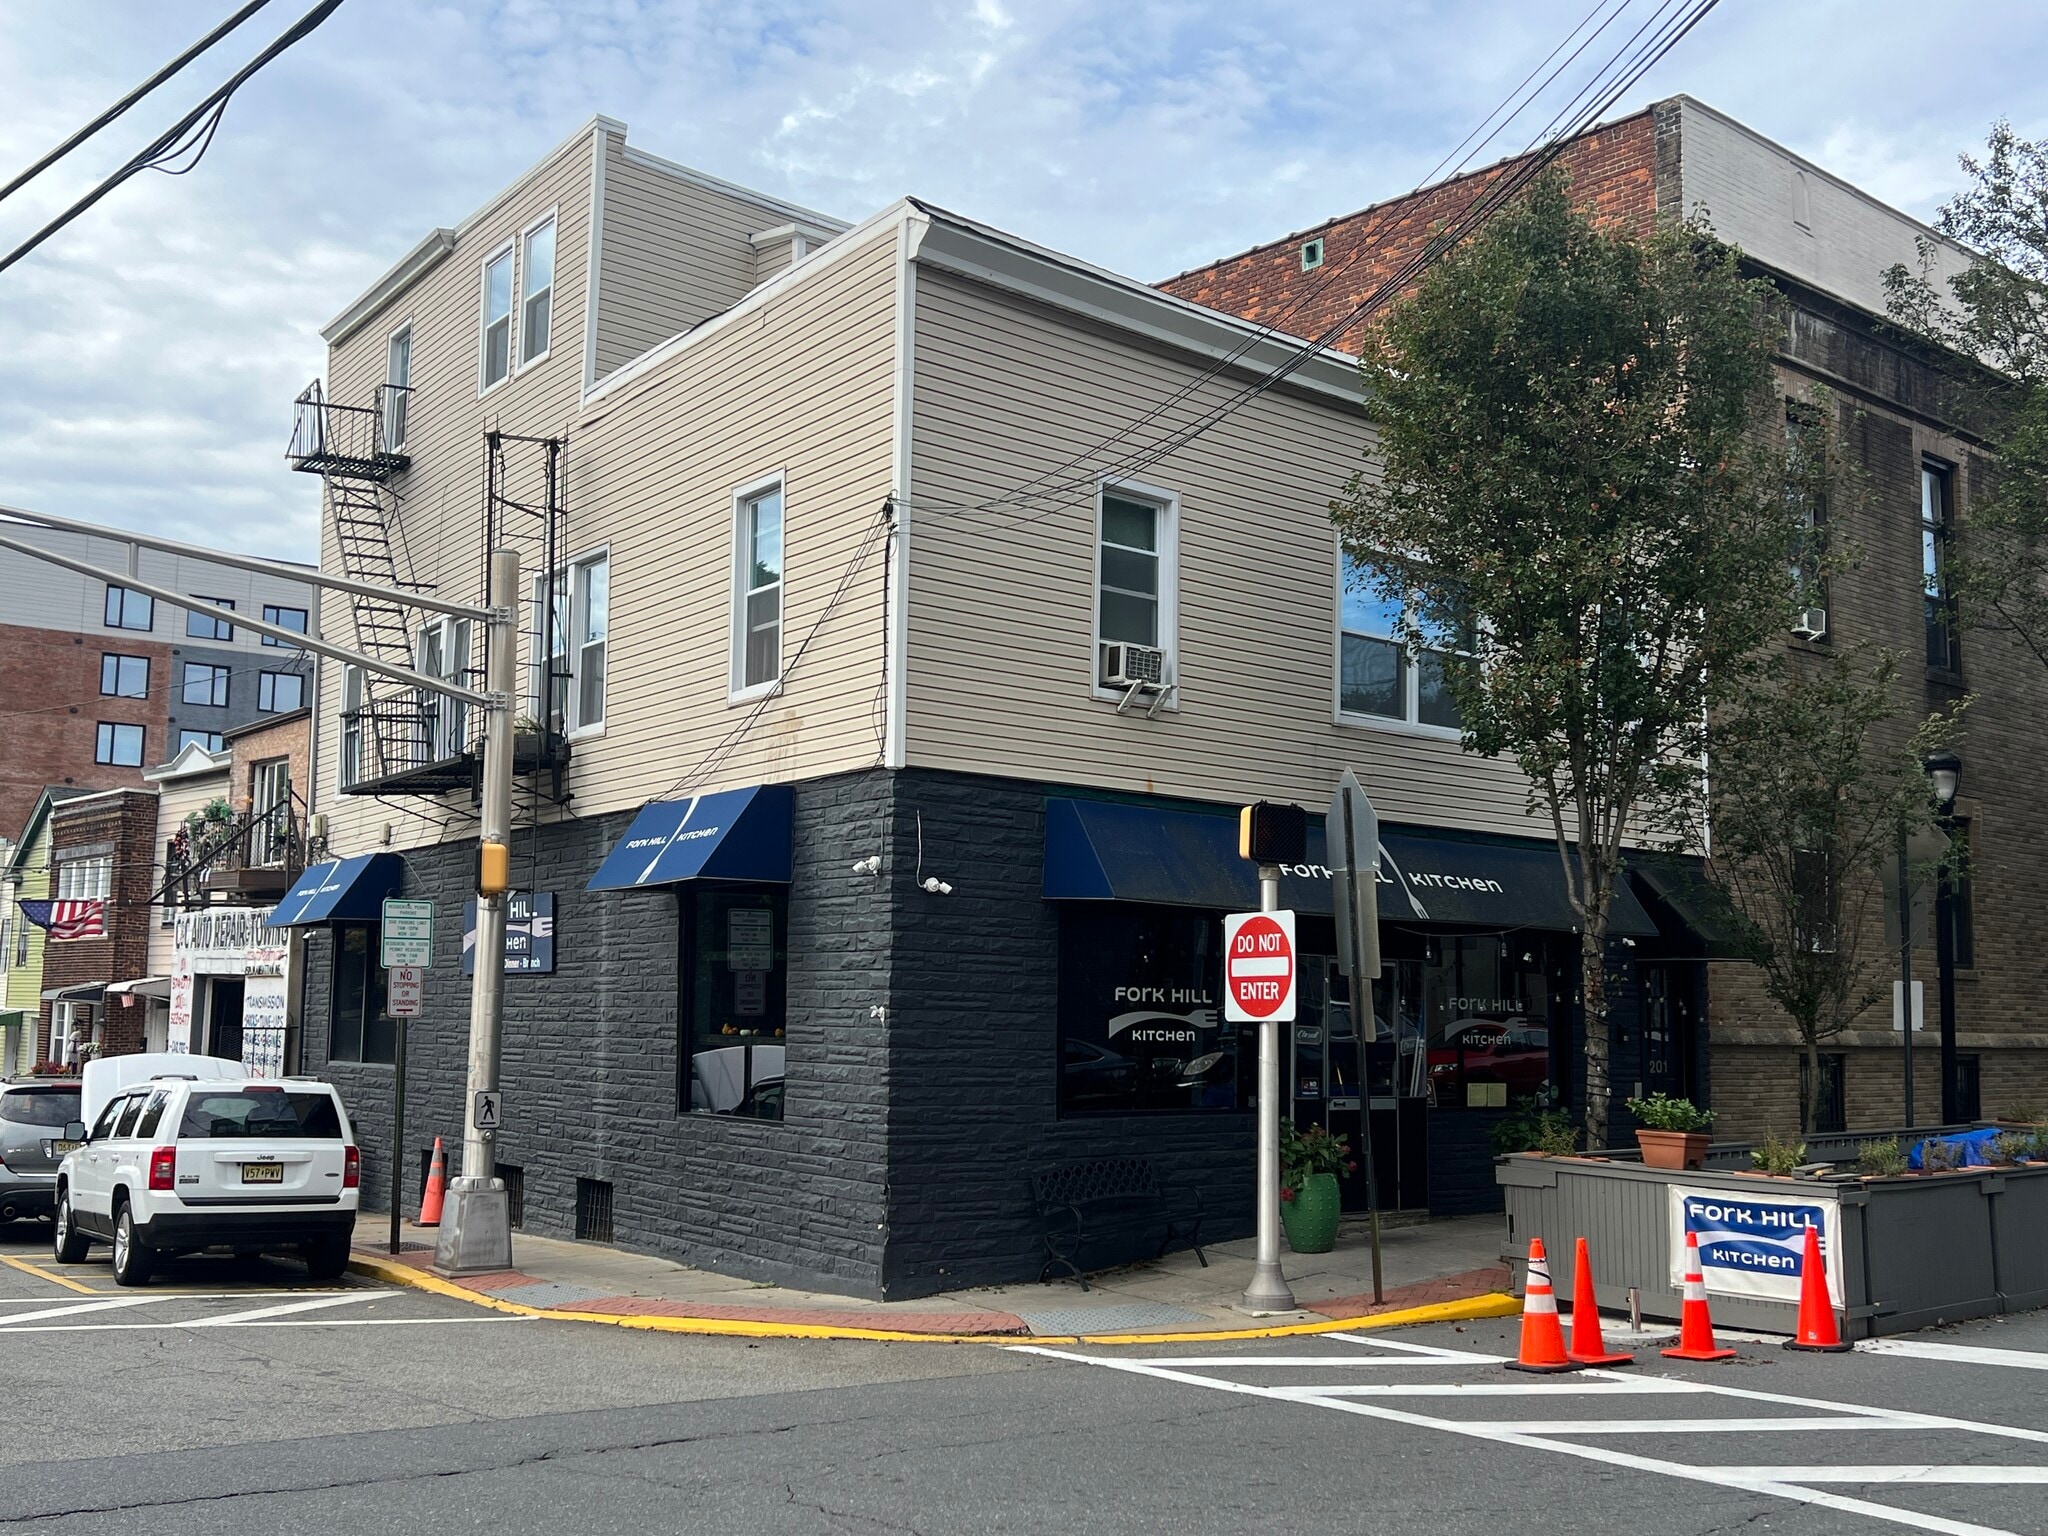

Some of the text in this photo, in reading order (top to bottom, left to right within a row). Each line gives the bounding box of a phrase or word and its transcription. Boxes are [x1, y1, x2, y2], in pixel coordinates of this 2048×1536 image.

[190, 914, 212, 949] AUTO
[1237, 933, 1282, 953] DO NOT
[523, 957, 540, 969] Brnch
[400, 971, 412, 981] NO
[1171, 988, 1213, 1004] HILL
[1240, 982, 1279, 1000] ENTER
[1492, 998, 1523, 1012] HILL
[1649, 1059, 1668, 1074] 201
[1760, 1210, 1818, 1230] HILL
